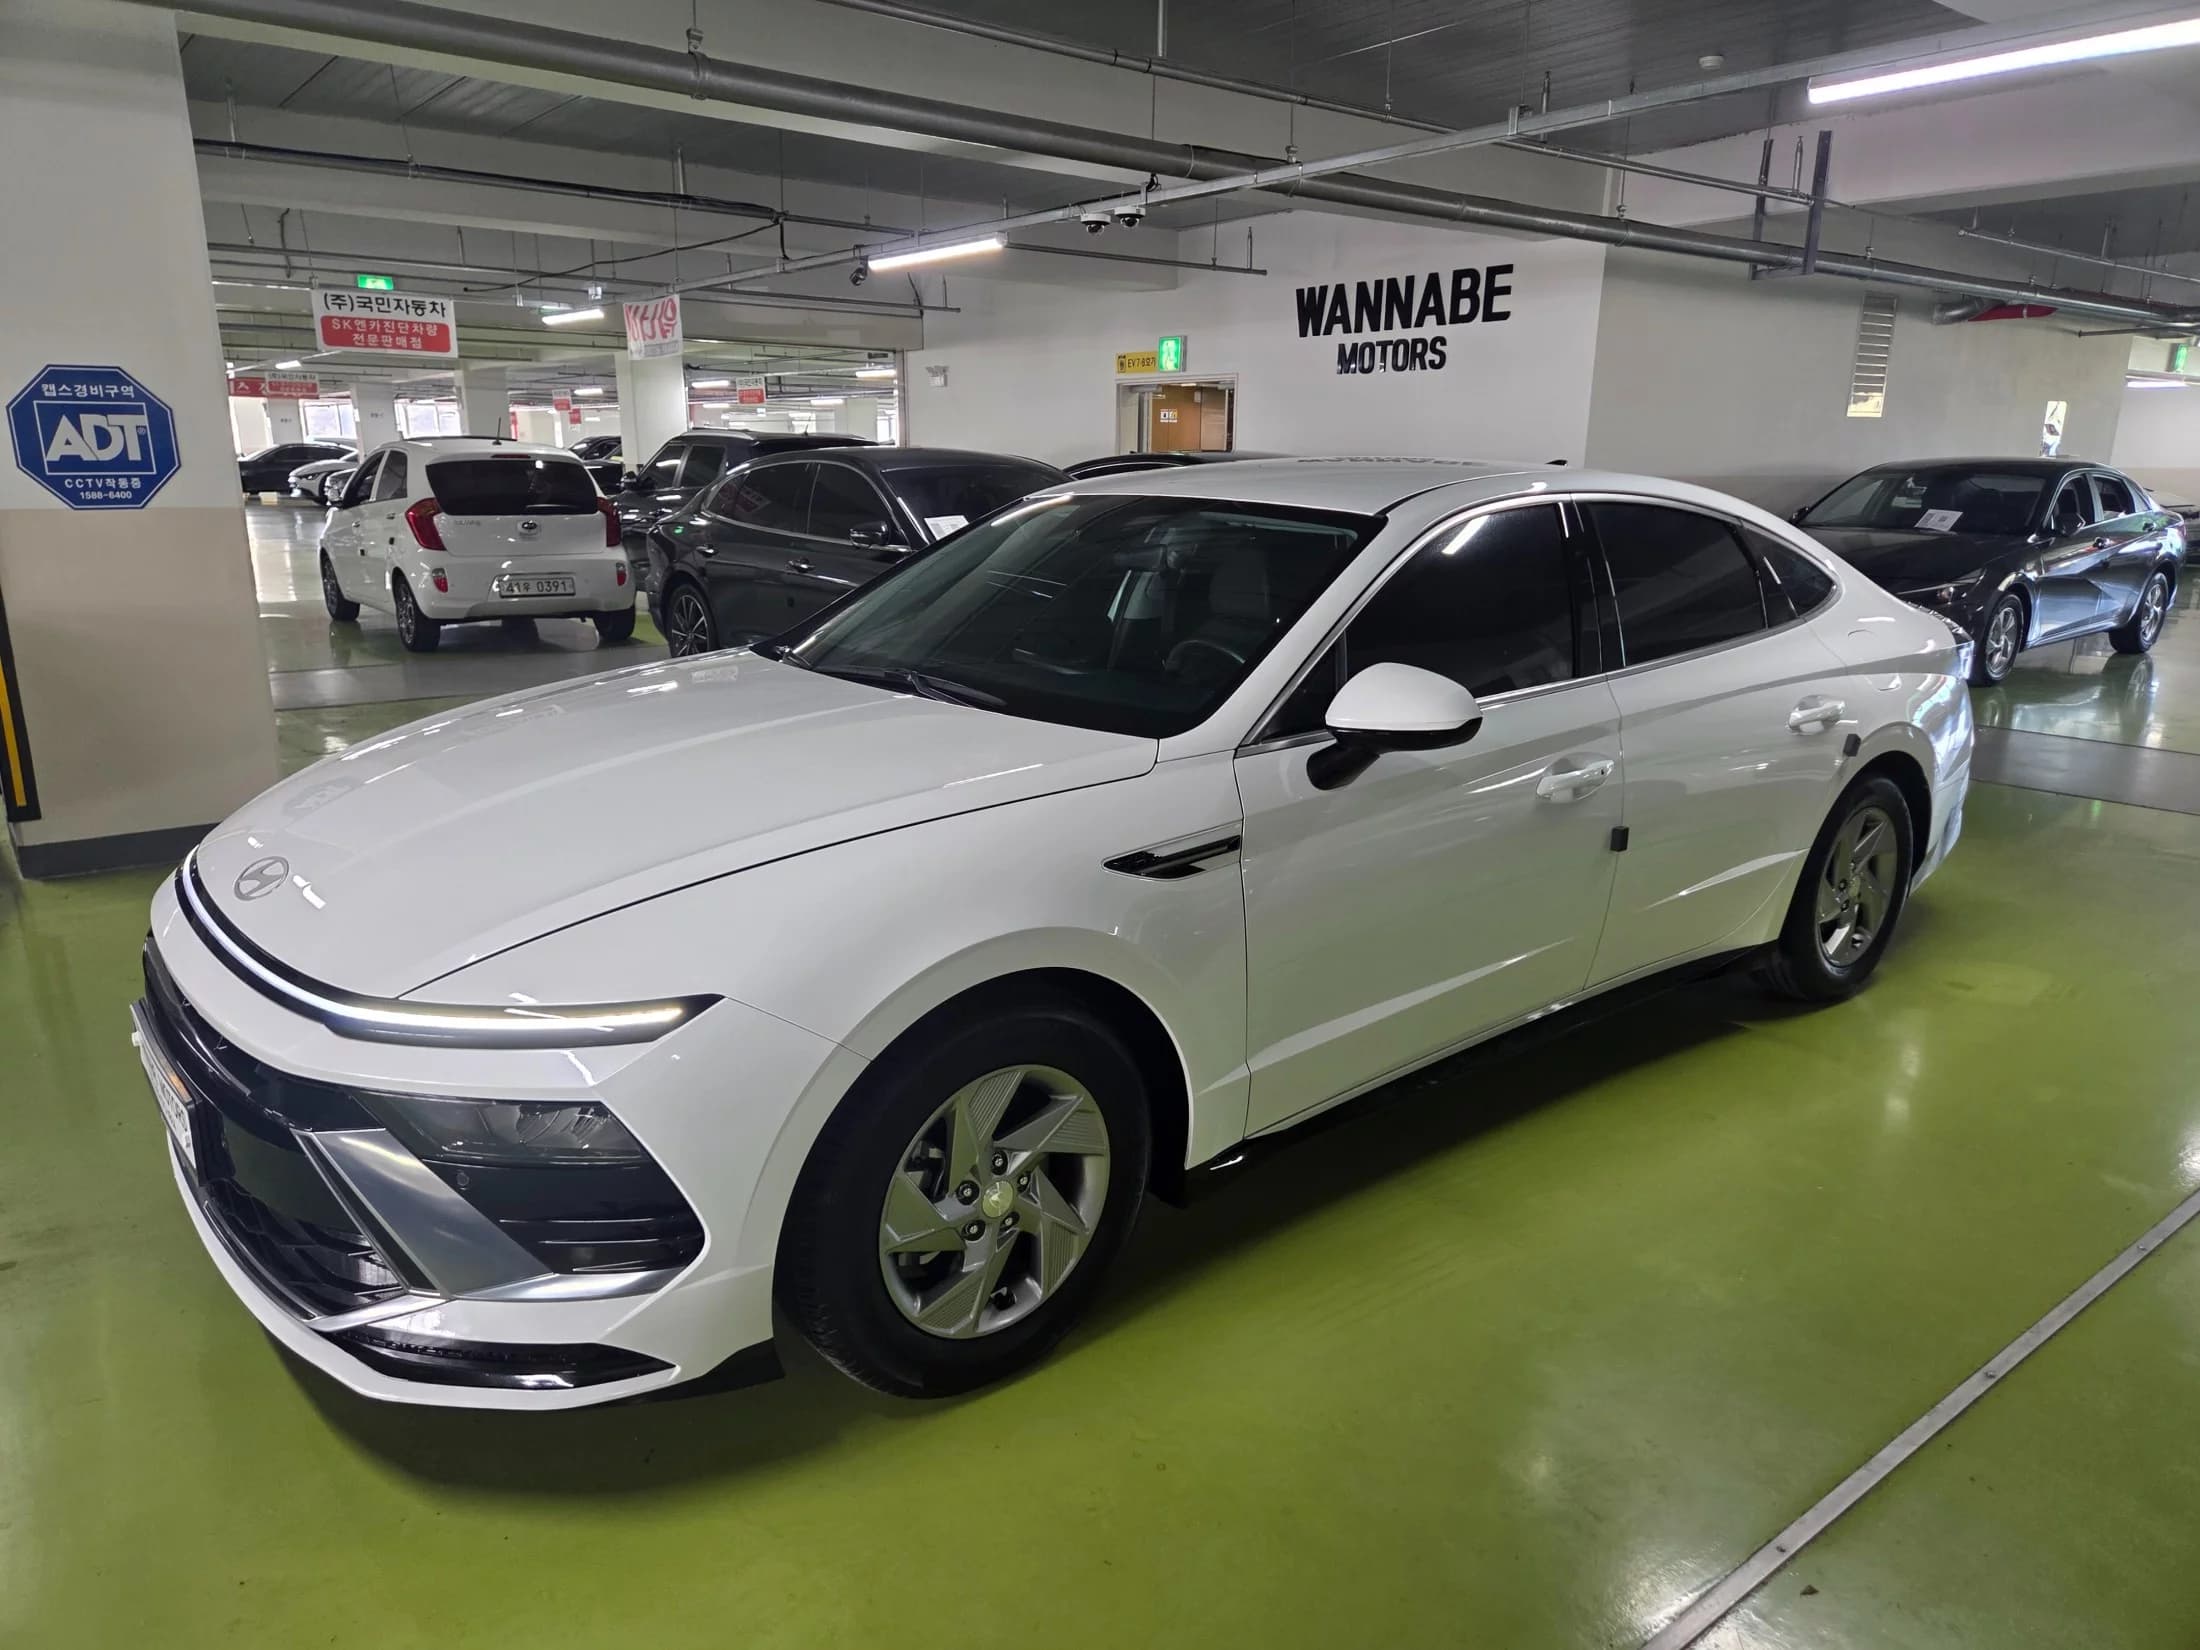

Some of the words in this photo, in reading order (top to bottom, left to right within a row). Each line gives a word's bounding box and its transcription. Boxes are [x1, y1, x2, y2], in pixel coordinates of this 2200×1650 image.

[324, 292, 446, 318] (주)국민자동차
[1296, 264, 1514, 338] WANNABE
[1336, 336, 1447, 375] MOTORS
[42, 383, 135, 398] 캡스경비구역
[46, 413, 148, 461] ADT
[64, 477, 142, 489] CCTV작동중
[80, 490, 133, 500] 1588-6400
[536, 580, 567, 592] 0391
